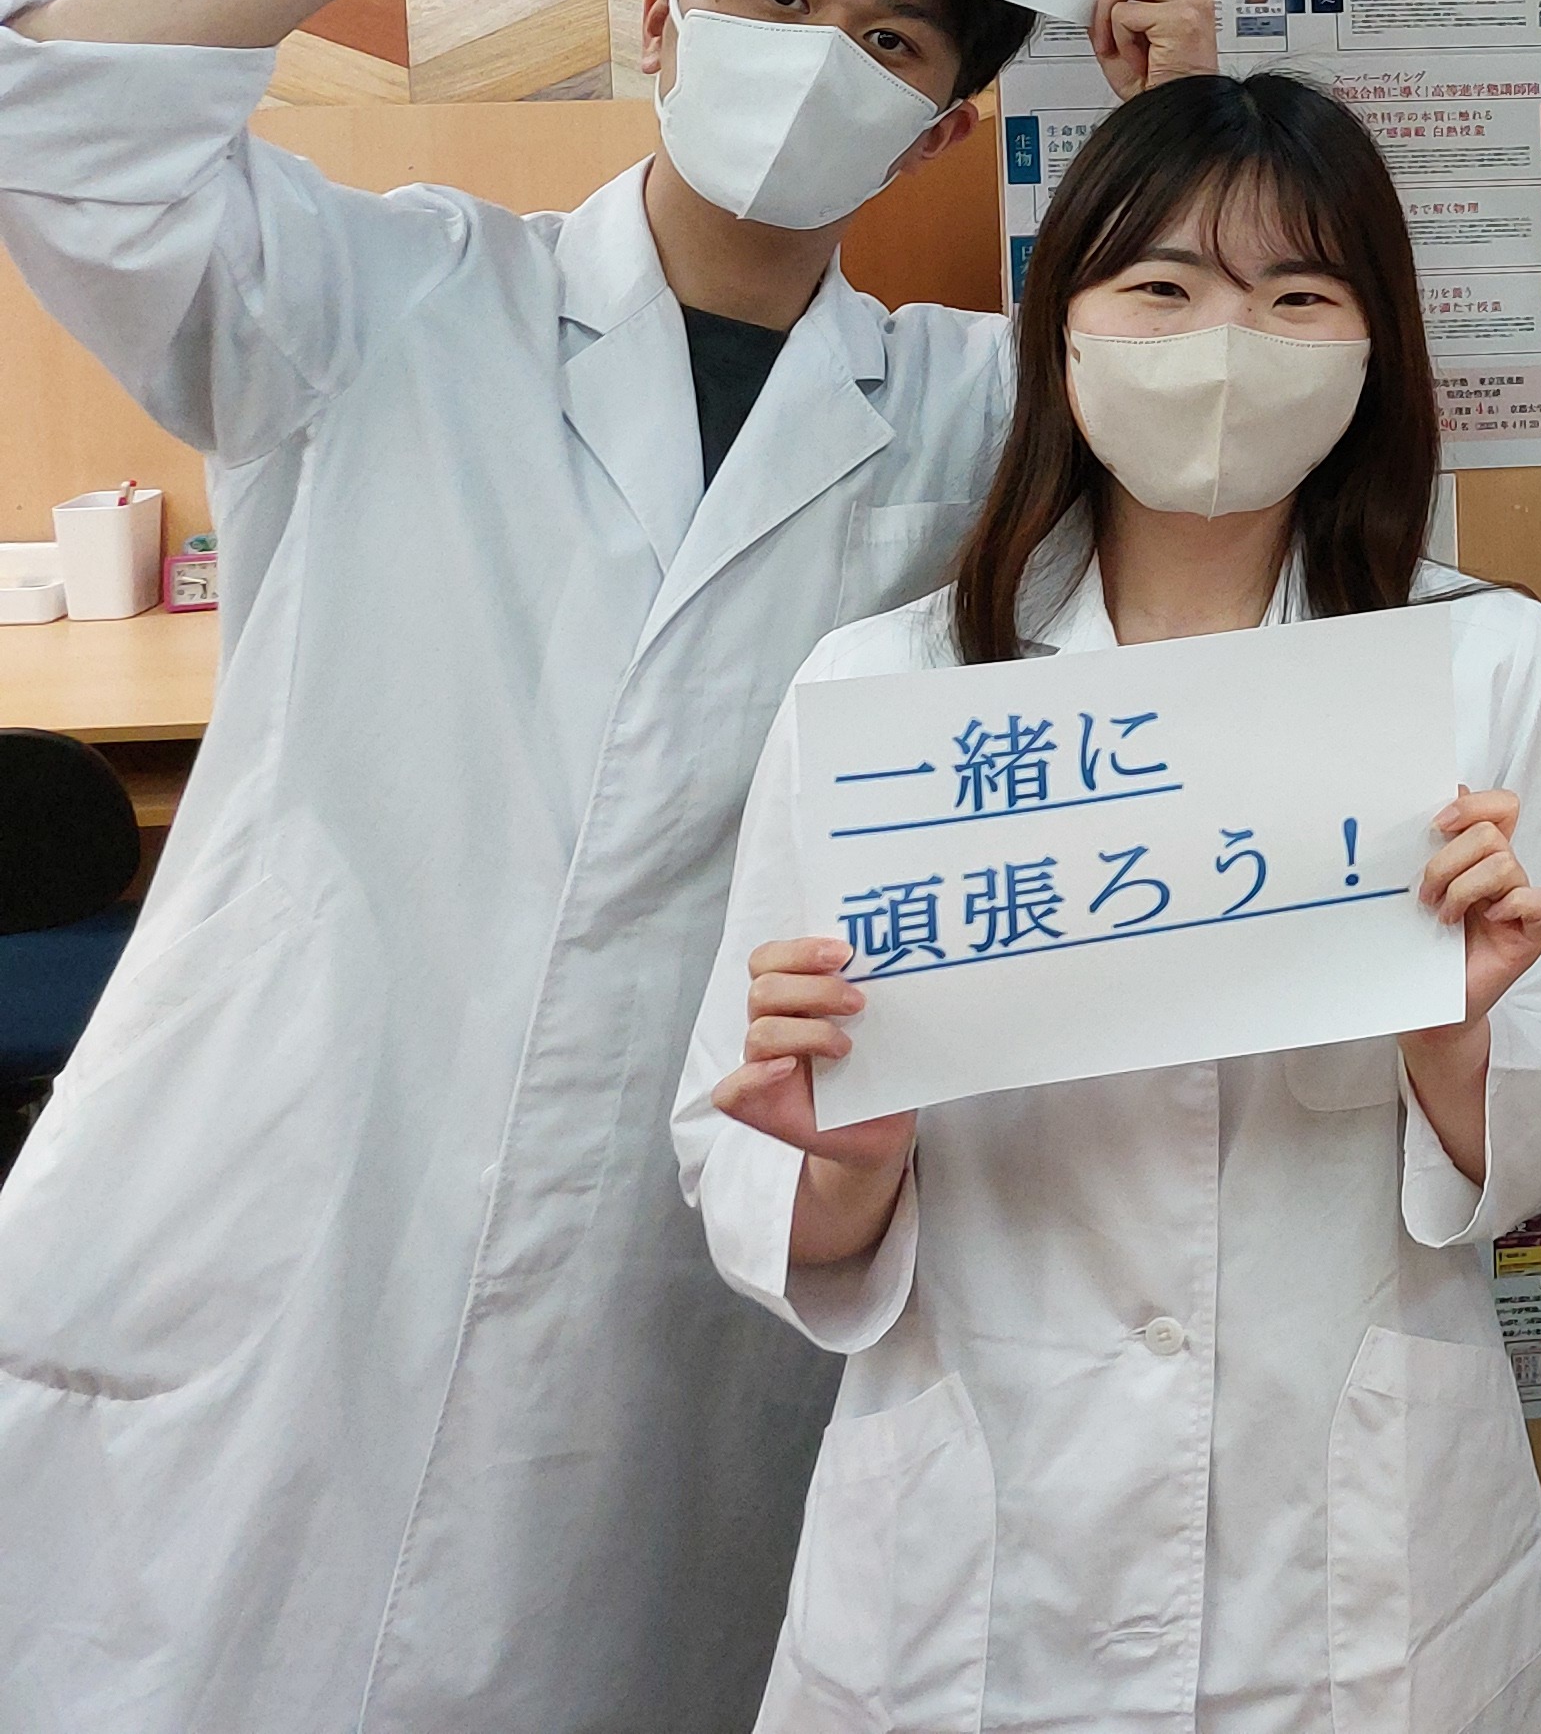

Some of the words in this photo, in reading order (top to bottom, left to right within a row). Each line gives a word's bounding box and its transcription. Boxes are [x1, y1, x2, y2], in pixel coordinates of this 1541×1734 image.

[1333, 70, 1427, 85] スーパーウイング
[1014, 134, 1033, 167] 生物
[833, 711, 1169, 813] 一緒に
[837, 817, 1363, 976] 頑張ろう！
